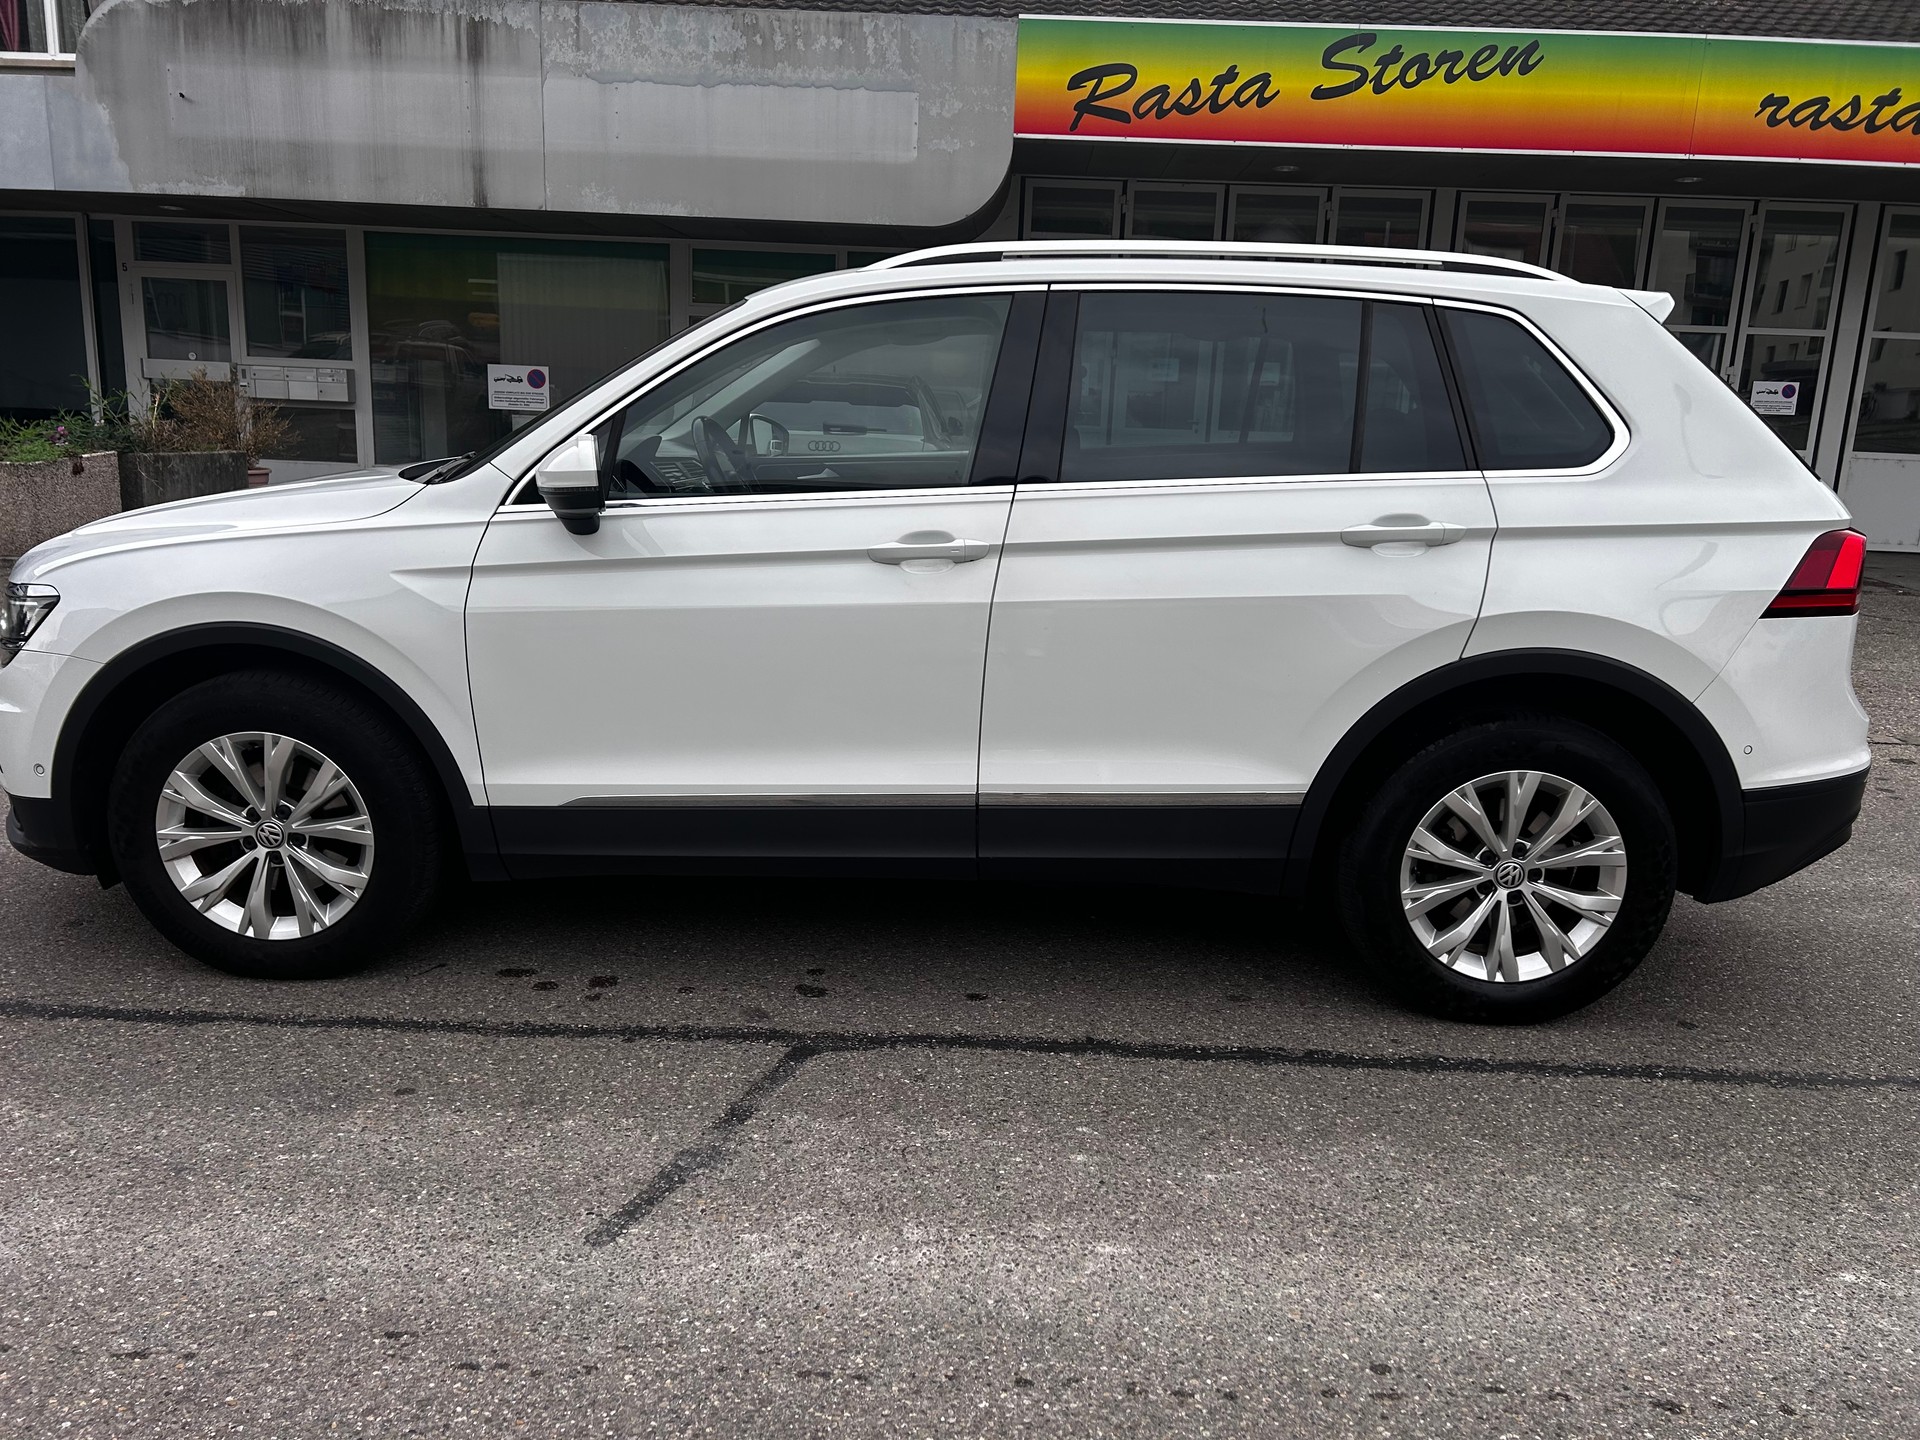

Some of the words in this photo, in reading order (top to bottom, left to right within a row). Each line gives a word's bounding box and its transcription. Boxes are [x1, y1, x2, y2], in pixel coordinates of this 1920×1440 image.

[1067, 62, 1281, 132] Rasta
[1310, 32, 1545, 101] Storen
[1754, 87, 1920, 136] rasta
[121, 262, 128, 272] 5
